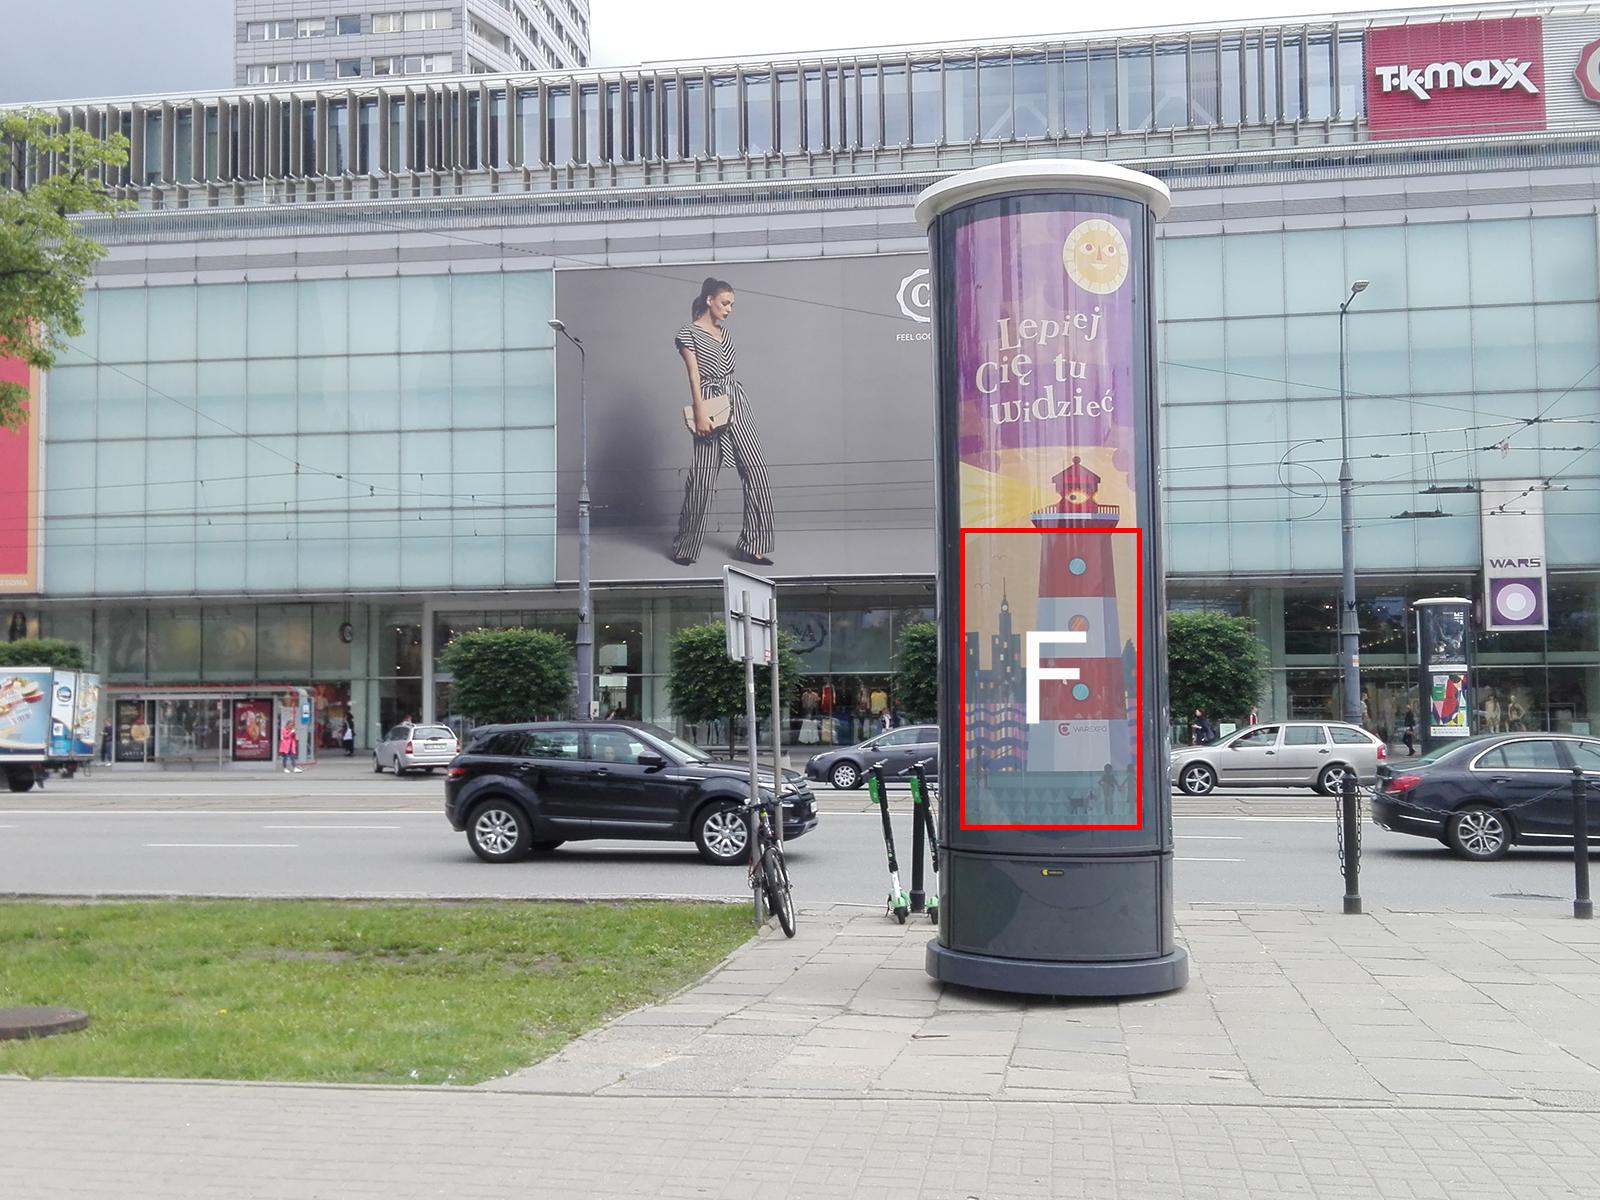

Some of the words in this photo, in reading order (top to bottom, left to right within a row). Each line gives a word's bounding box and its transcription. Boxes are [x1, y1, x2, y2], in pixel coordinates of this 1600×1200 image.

[896, 333, 915, 341] FEEL
[997, 306, 1102, 351] Lepiej
[975, 352, 1033, 393] Cię
[1053, 353, 1088, 382] tu
[990, 385, 1114, 424] widzieć
[1489, 558, 1541, 568] WARS
